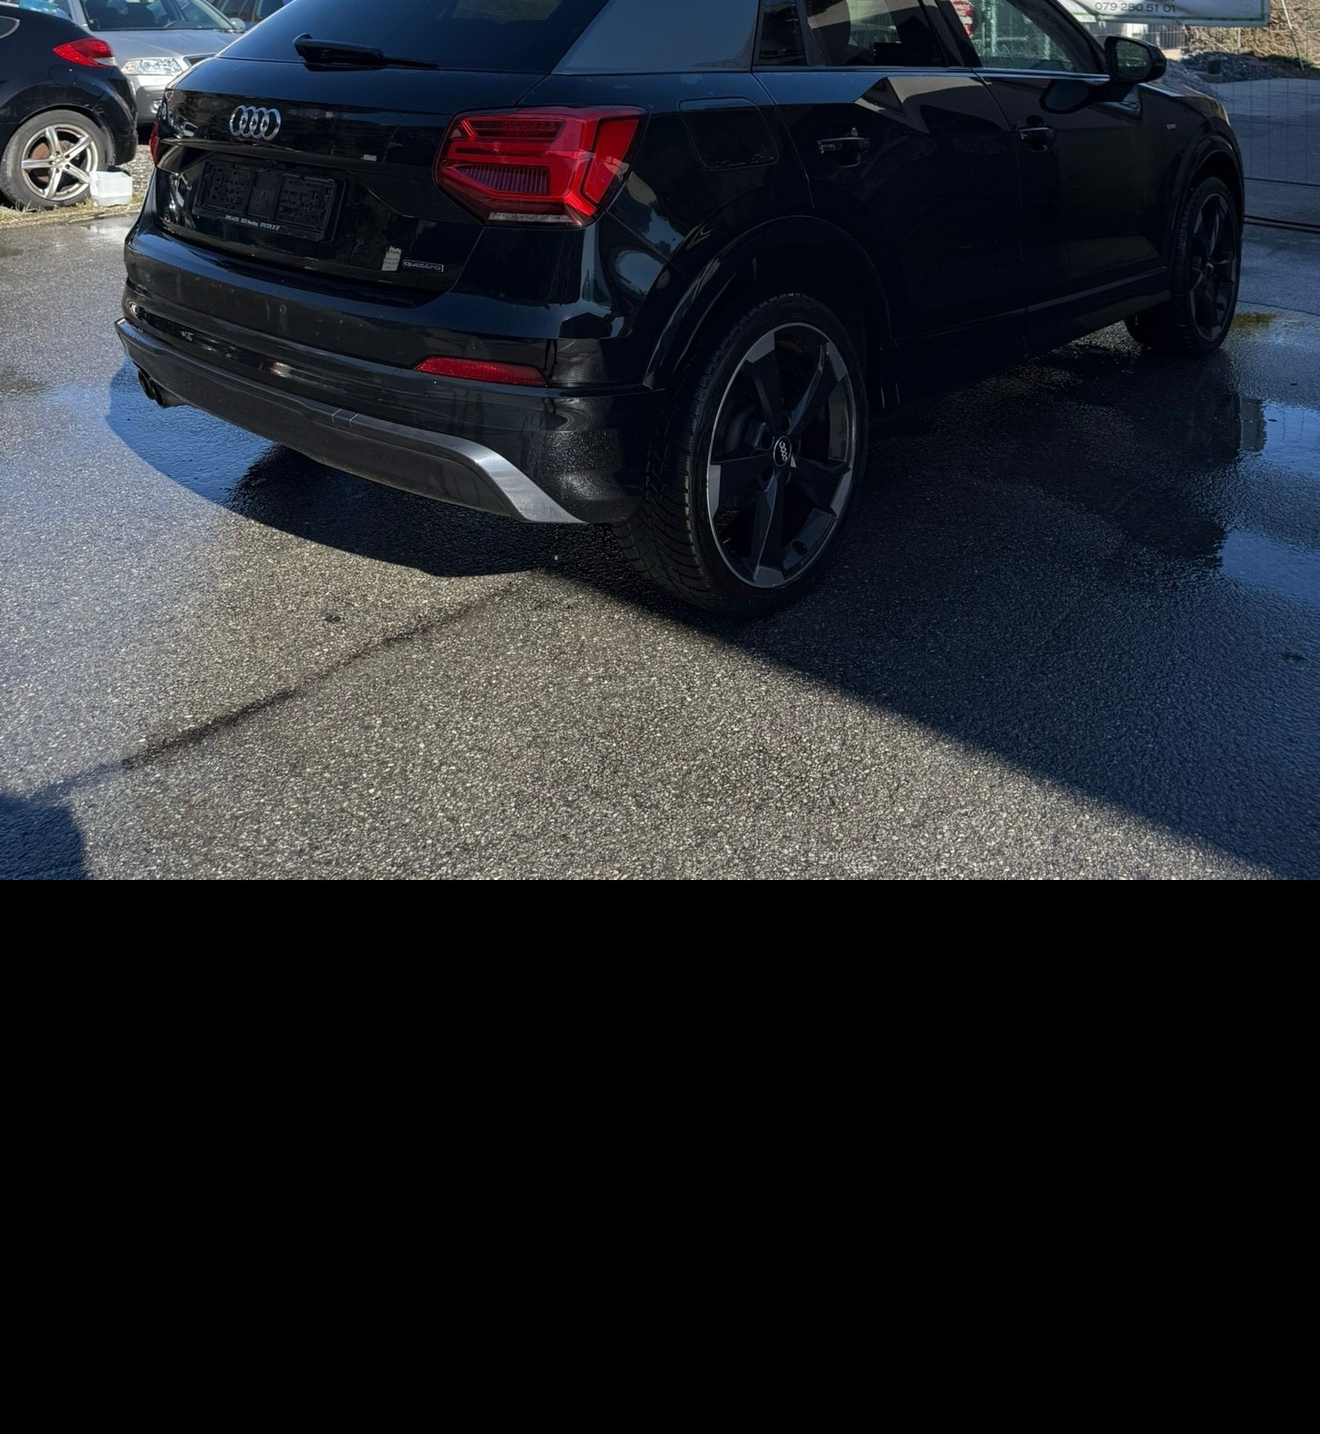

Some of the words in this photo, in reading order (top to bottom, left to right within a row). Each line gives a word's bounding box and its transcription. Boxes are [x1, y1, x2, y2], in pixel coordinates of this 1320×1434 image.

[1094, 2, 1118, 12] 079
[1121, 3, 1144, 12] 280
[1146, 3, 1159, 13] 51
[1163, 4, 1176, 14] 01
